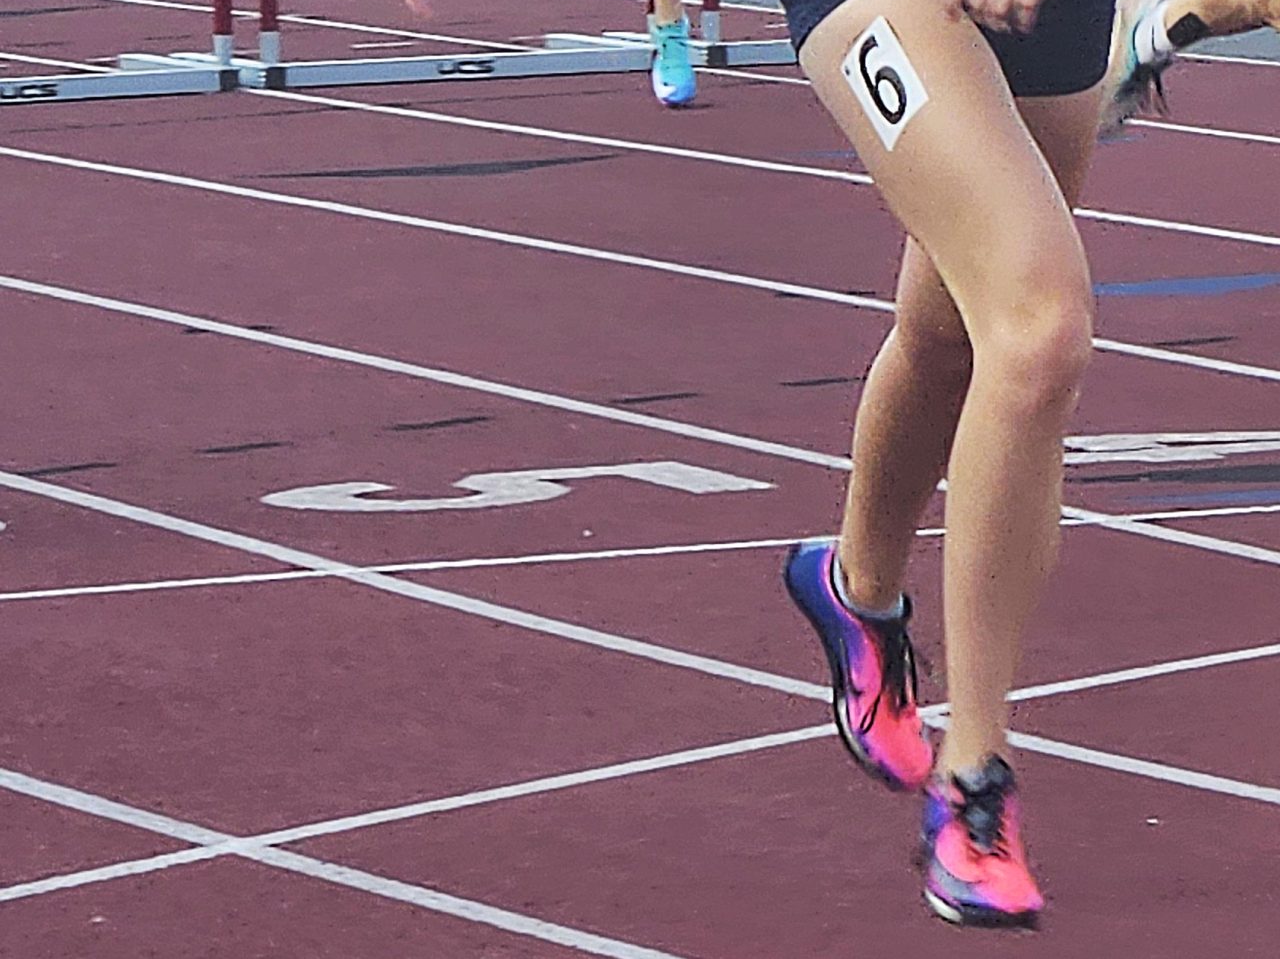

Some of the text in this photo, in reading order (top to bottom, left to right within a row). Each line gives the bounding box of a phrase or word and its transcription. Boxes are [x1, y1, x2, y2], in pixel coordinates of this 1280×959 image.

[437, 59, 496, 76] UCS
[858, 36, 907, 125] 6
[0, 82, 58, 99] UCS
[260, 461, 778, 511] 5
